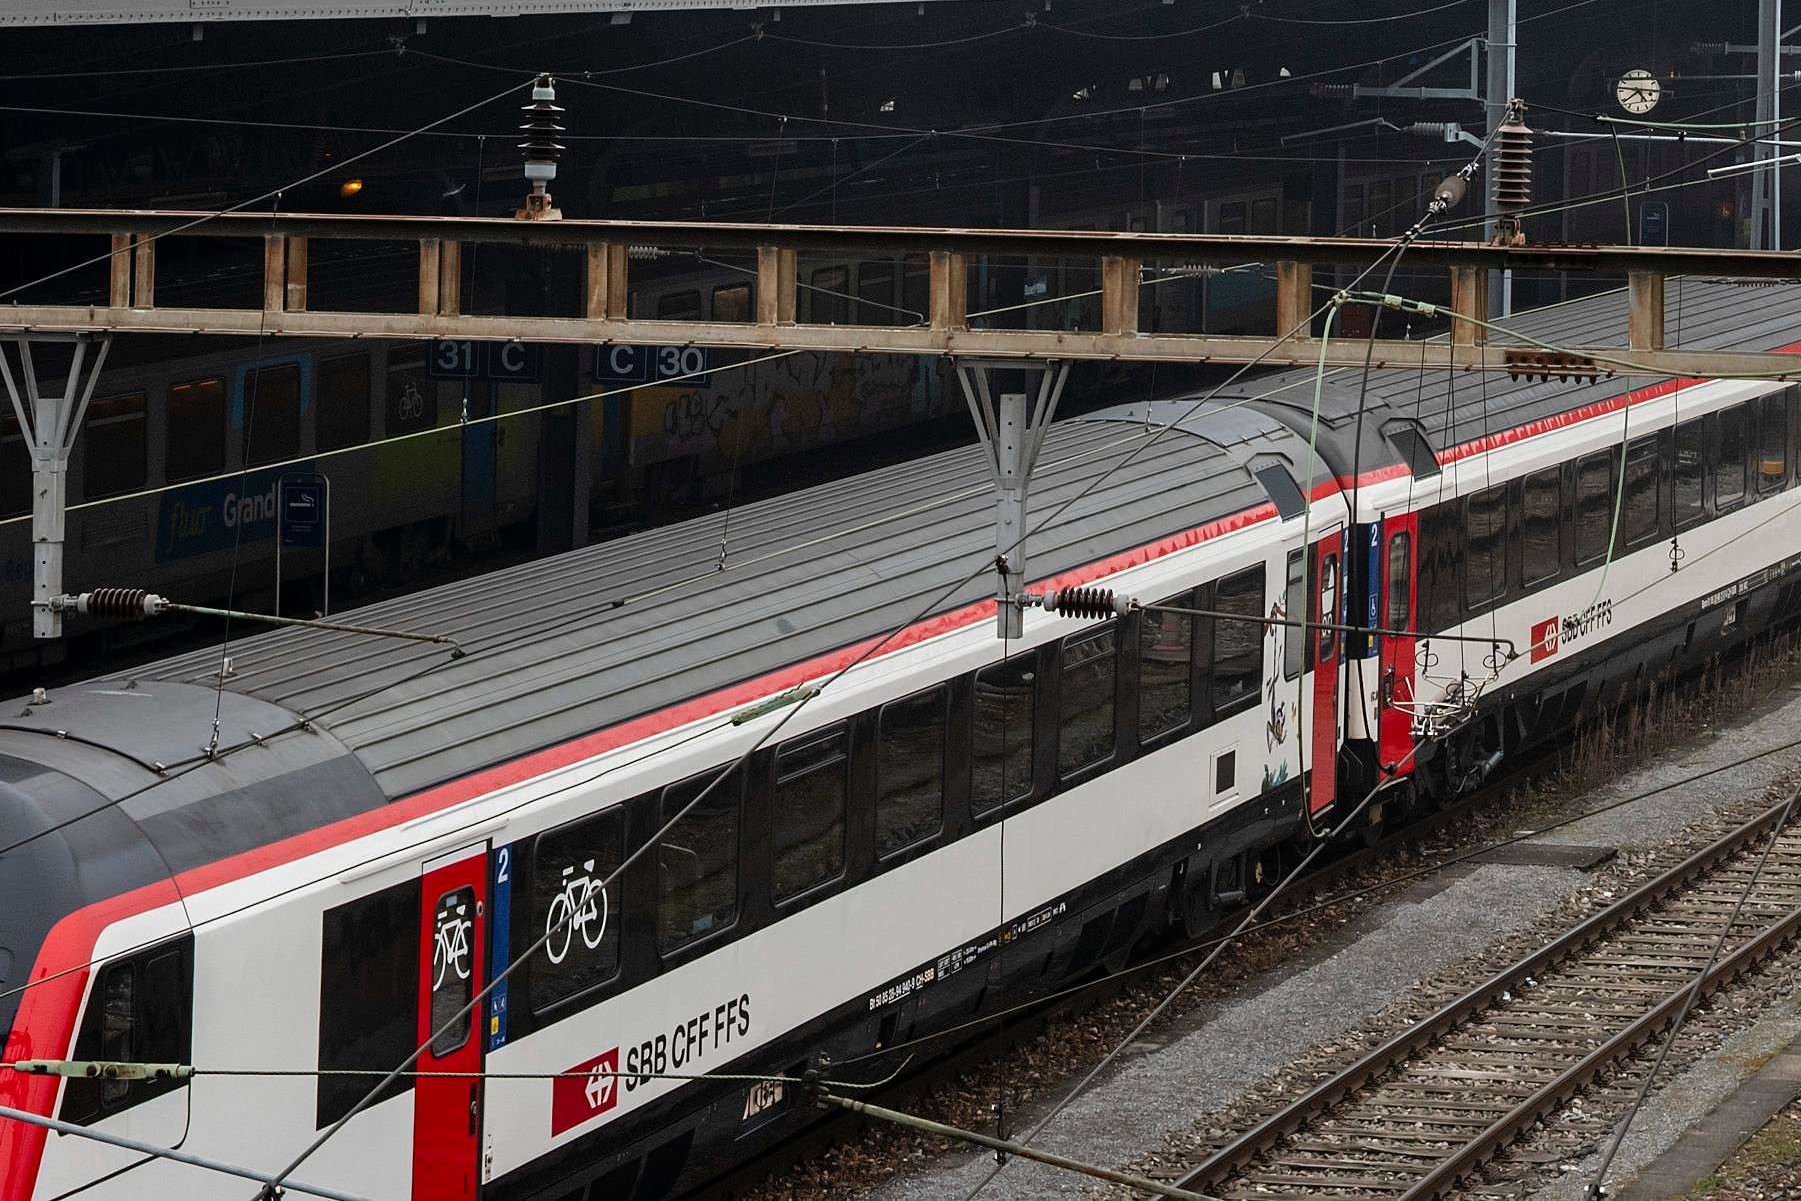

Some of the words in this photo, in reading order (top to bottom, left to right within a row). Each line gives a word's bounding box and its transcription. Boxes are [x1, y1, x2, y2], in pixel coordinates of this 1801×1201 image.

[438, 340, 472, 370] 31
[501, 342, 525, 371] C
[610, 344, 634, 374] C
[659, 346, 704, 376] 30
[223, 483, 277, 528] Grand
[1344, 529, 1349, 553] 2
[1371, 523, 1378, 547] 2
[497, 847, 509, 884] 2
[625, 1033, 667, 1092] SBB
[672, 1012, 710, 1069] CFF
[714, 993, 750, 1050] FFS
